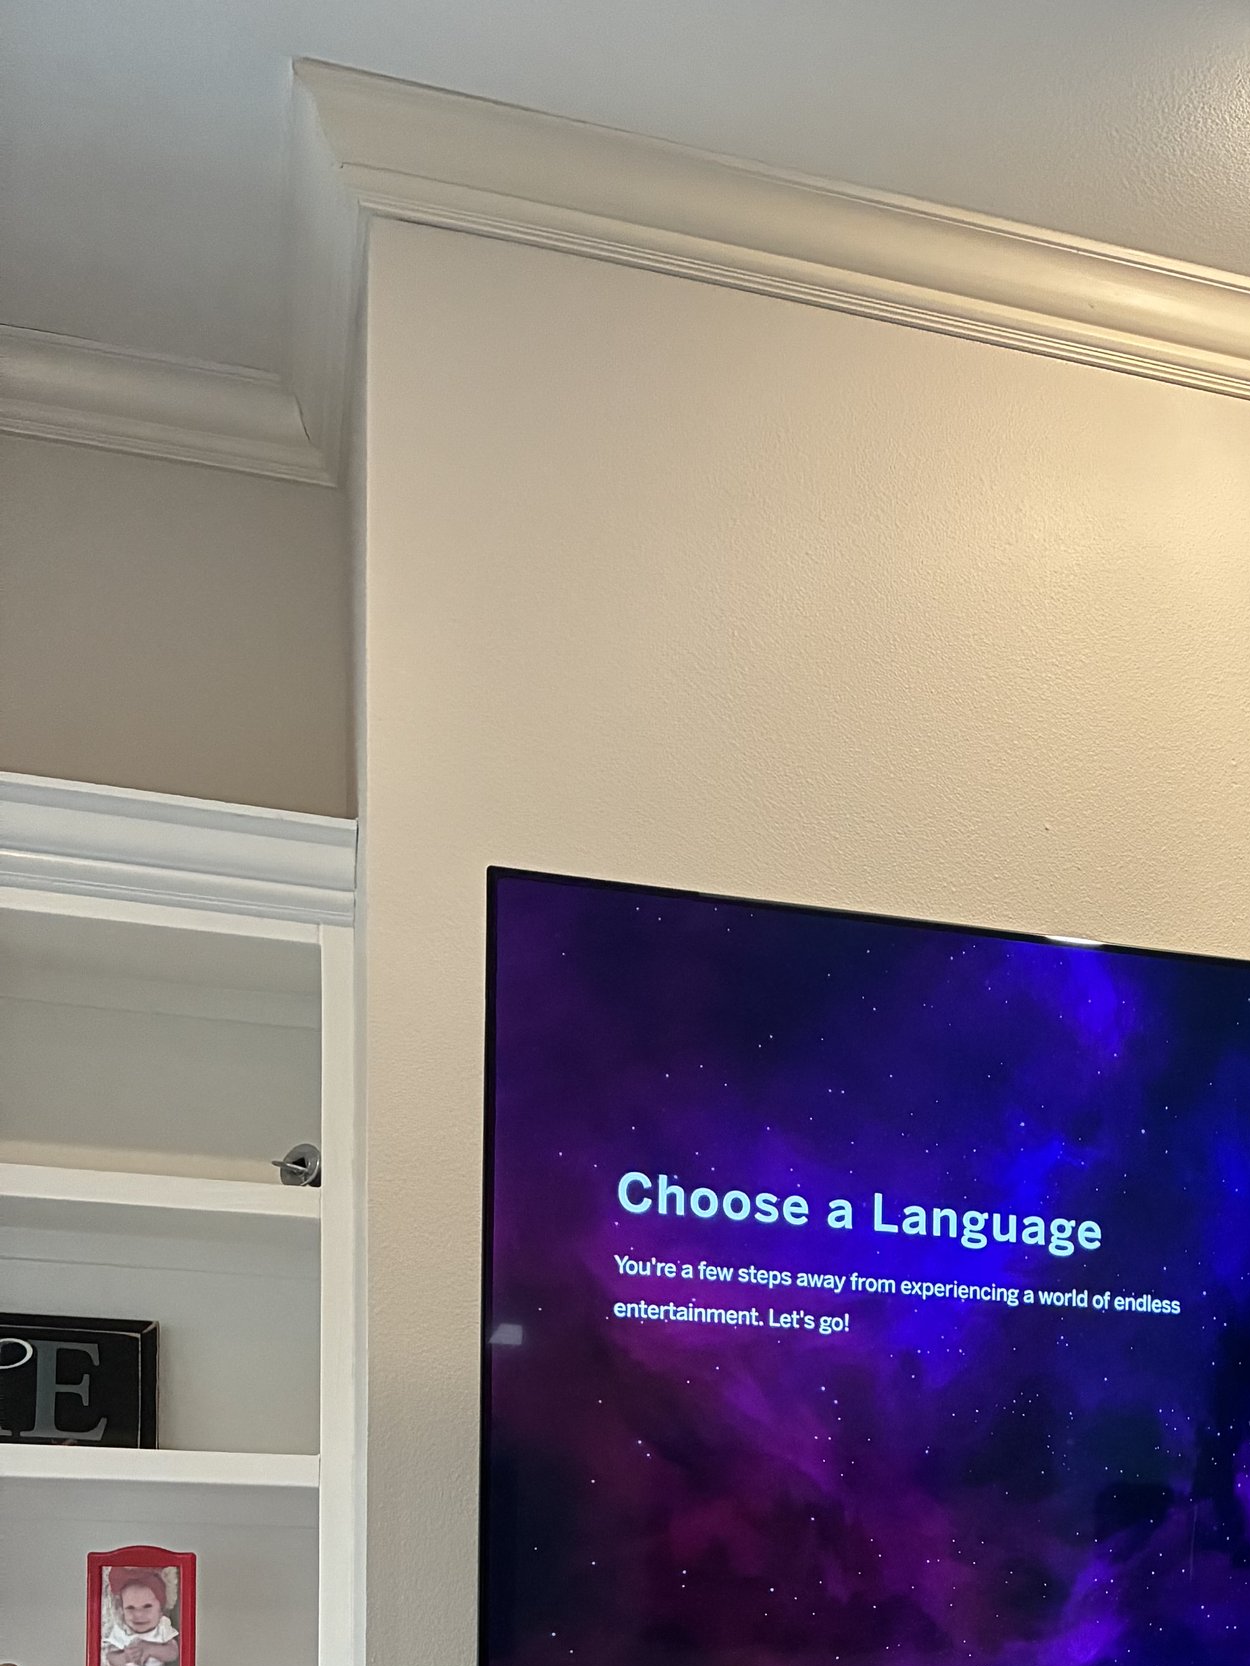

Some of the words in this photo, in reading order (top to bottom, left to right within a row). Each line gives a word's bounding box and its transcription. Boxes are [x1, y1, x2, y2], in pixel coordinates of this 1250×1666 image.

[617, 1171, 809, 1226] Choose
[827, 1198, 853, 1230] a
[873, 1192, 1102, 1257] Language
[613, 1254, 677, 1278] You're
[680, 1263, 694, 1279] a
[697, 1260, 734, 1282] few
[737, 1265, 793, 1289] steps
[796, 1272, 847, 1294] away
[849, 1272, 896, 1294] from
[900, 1280, 1020, 1307] experiencing
[1022, 1289, 1035, 1304] a
[1038, 1288, 1089, 1308] world
[1091, 1290, 1111, 1310] of
[1113, 1294, 1181, 1315] endless
[613, 1300, 764, 1327] entertainment.
[768, 1308, 816, 1330] Let's
[818, 1313, 850, 1335] go!
